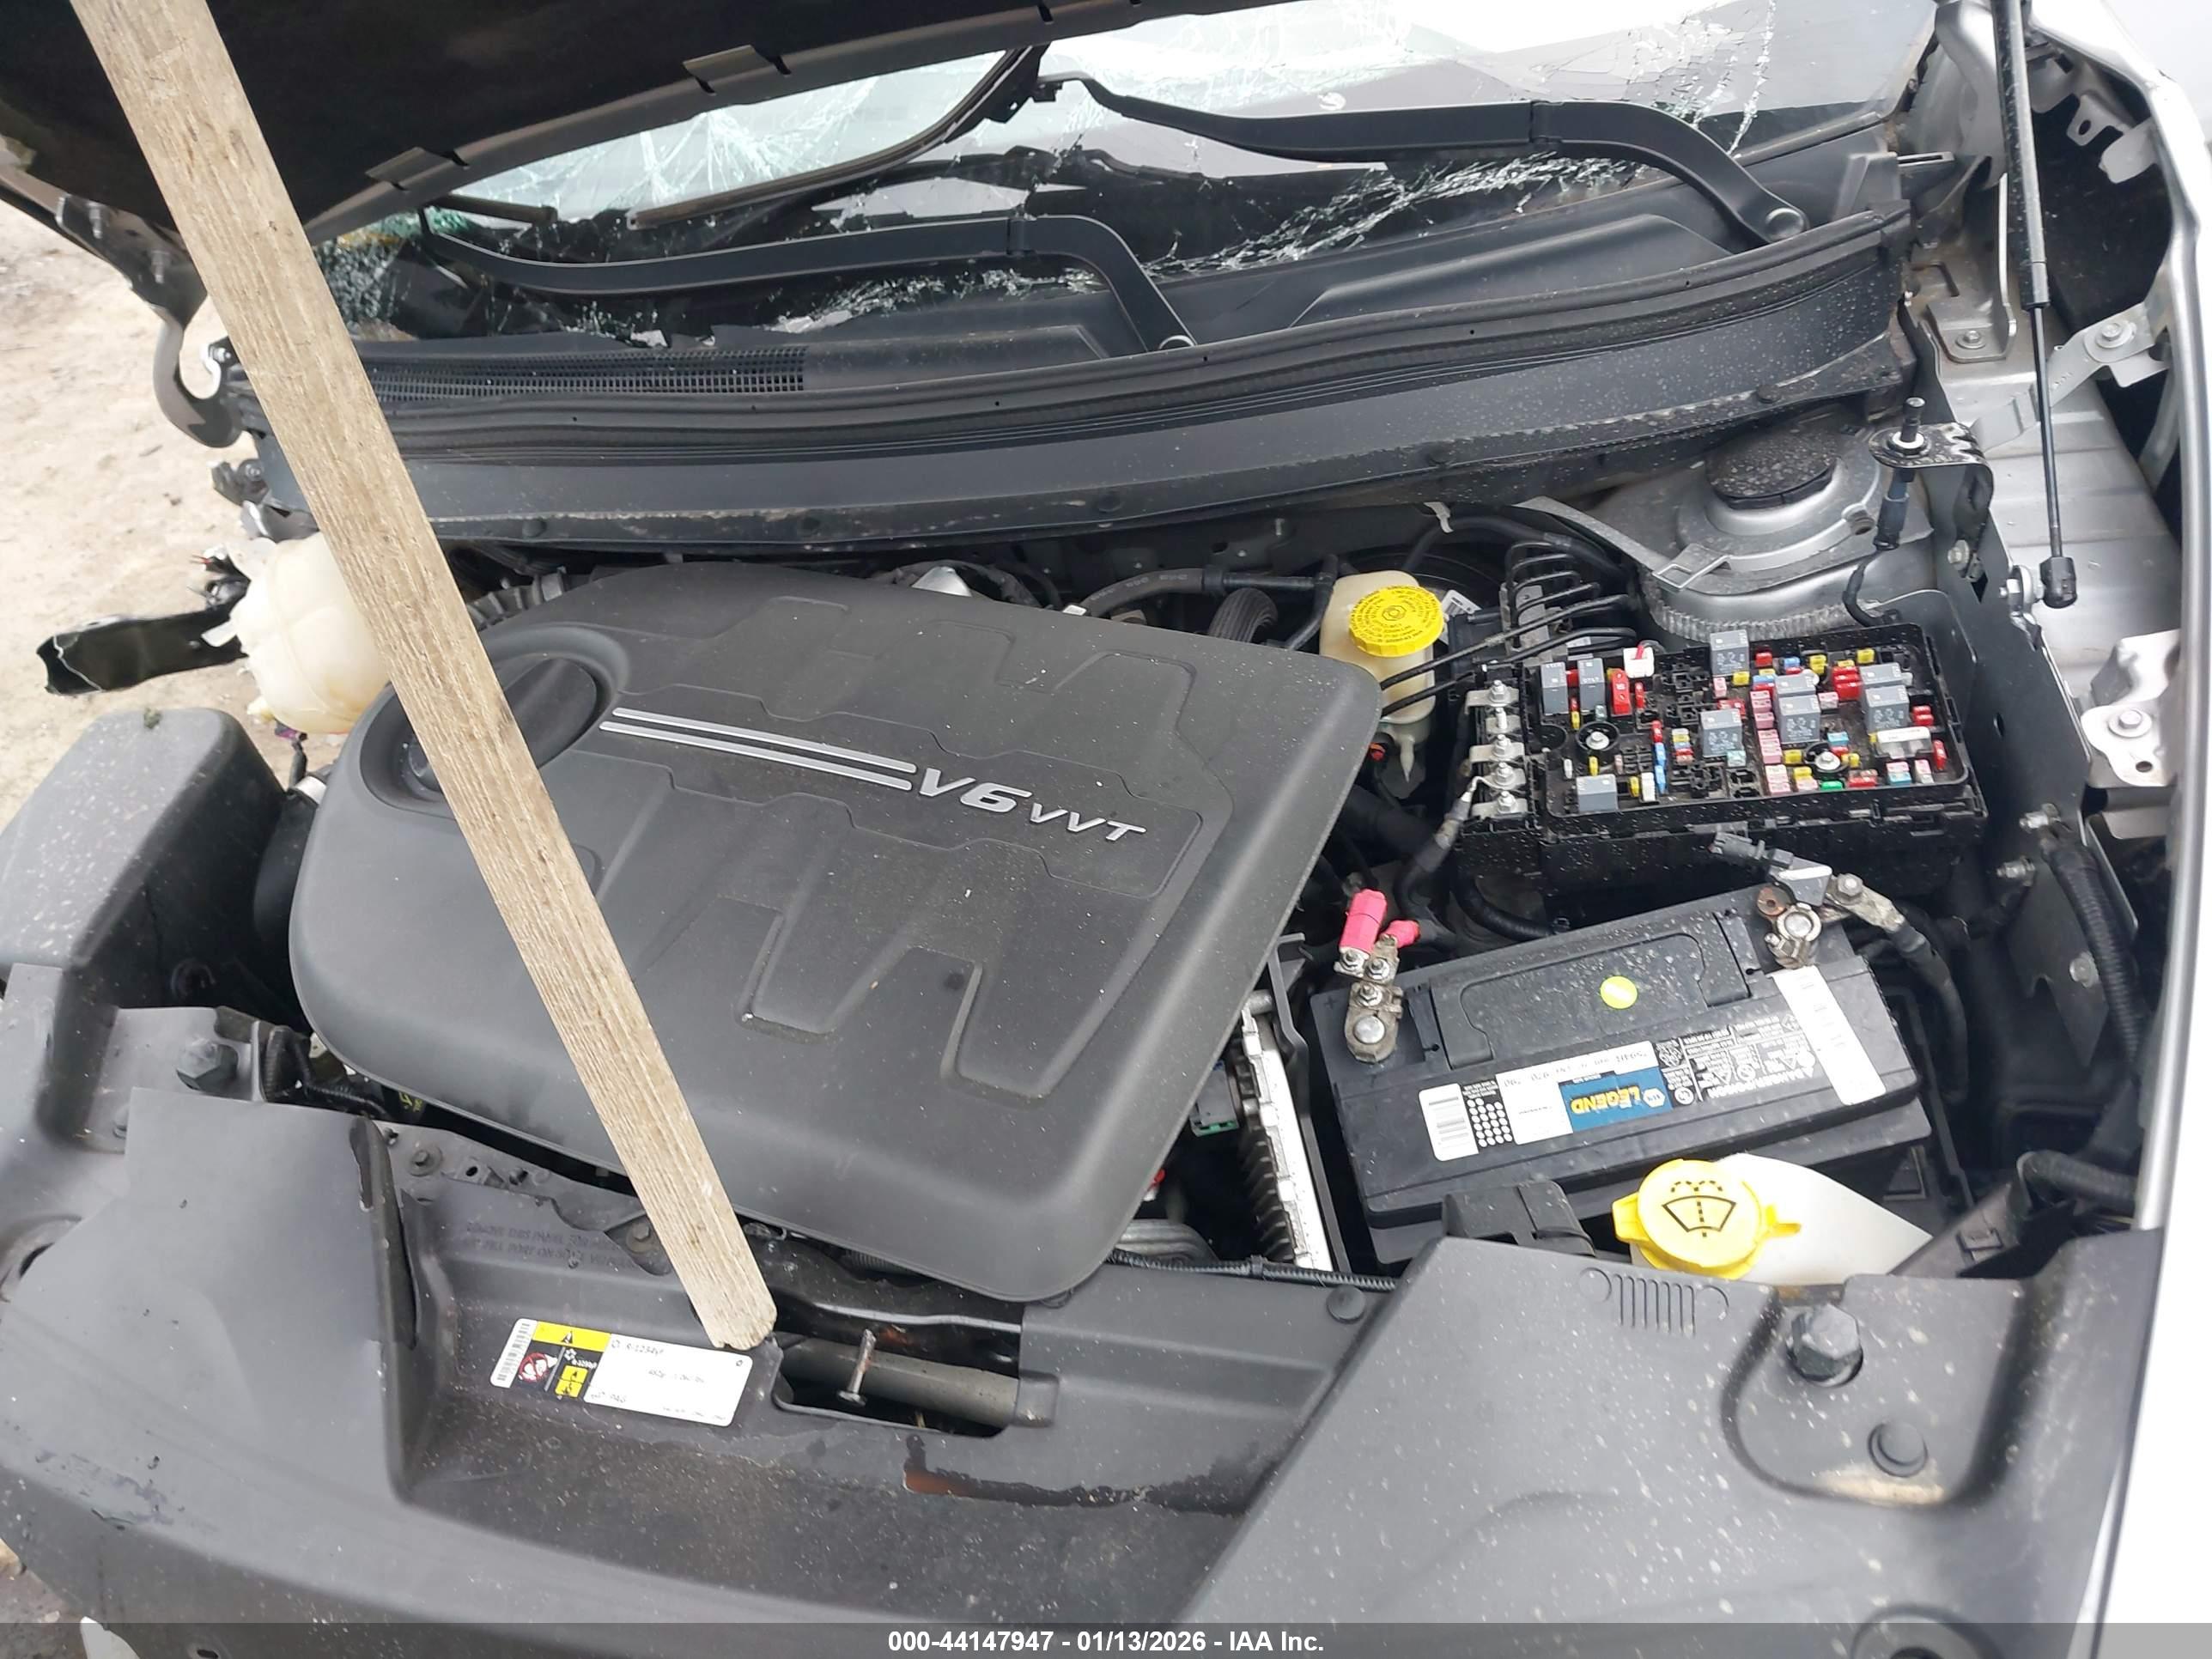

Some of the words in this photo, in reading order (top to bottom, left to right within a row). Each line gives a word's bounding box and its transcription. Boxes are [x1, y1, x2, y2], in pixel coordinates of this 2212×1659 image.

[919, 767, 1033, 813] V6
[1030, 802, 1148, 842] VVT
[1570, 1085, 1642, 1115] LEGEND
